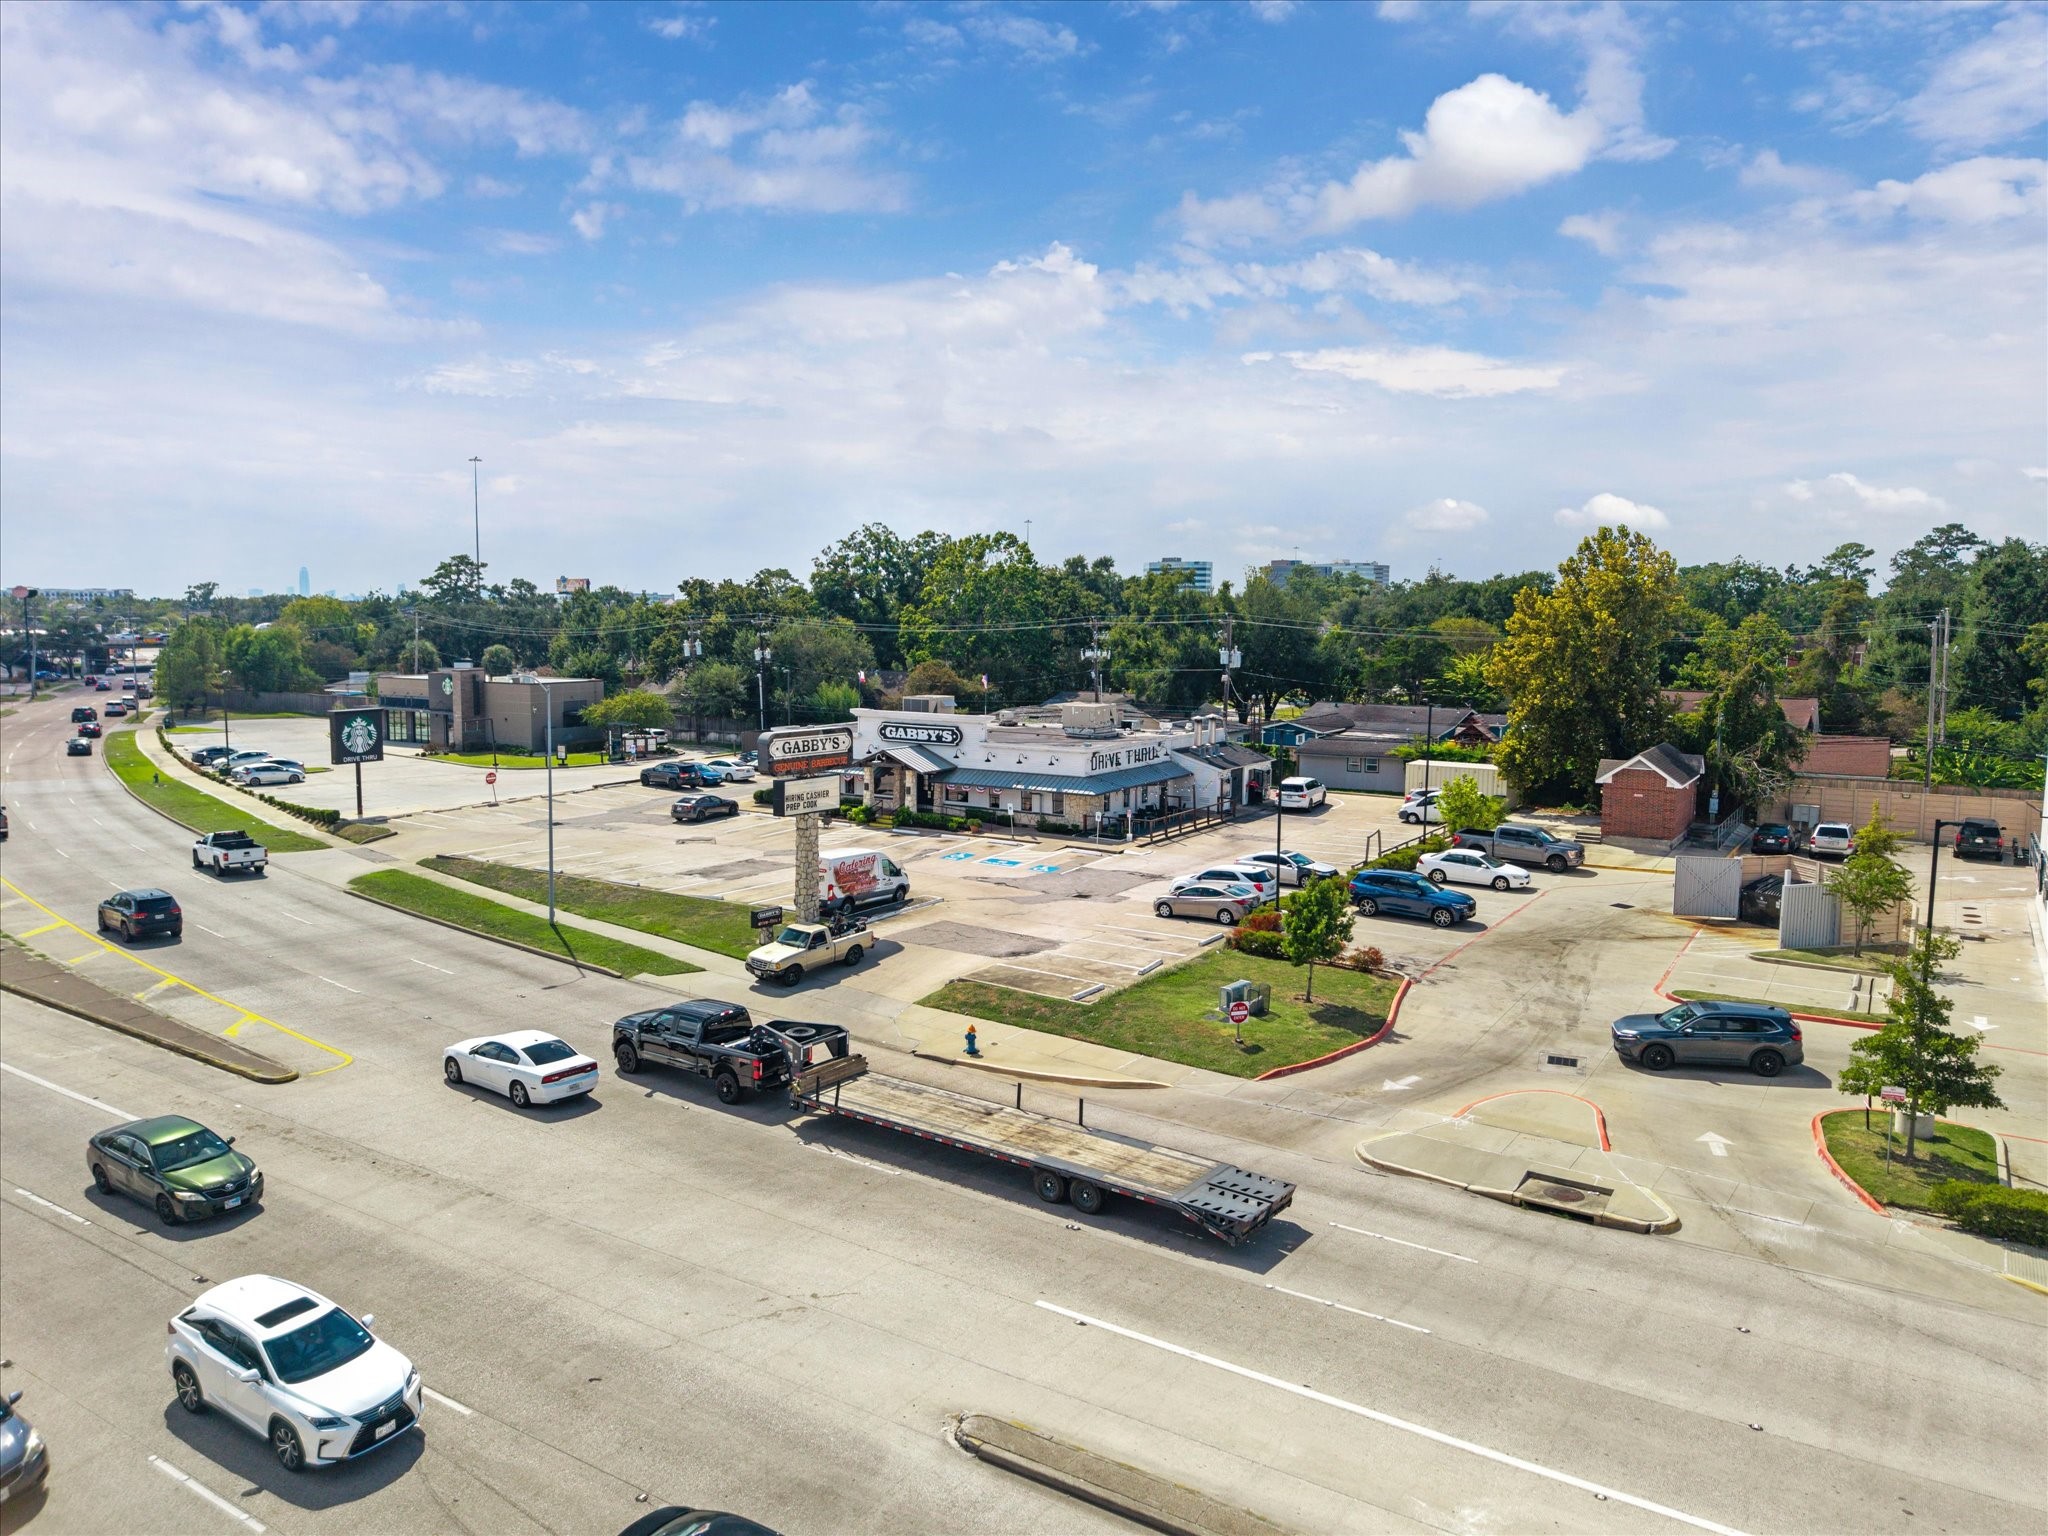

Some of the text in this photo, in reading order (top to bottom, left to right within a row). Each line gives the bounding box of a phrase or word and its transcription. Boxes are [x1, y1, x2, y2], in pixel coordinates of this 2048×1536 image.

[885, 727, 953, 742] GABBY'S
[782, 737, 840, 754] GABBY'S
[774, 761, 808, 771] GENUINE
[1091, 746, 1155, 771] DRIVE THRU
[786, 790, 830, 802] HIRING CASHIER
[786, 800, 817, 812] PREP COOK
[840, 855, 876, 874] Catering
